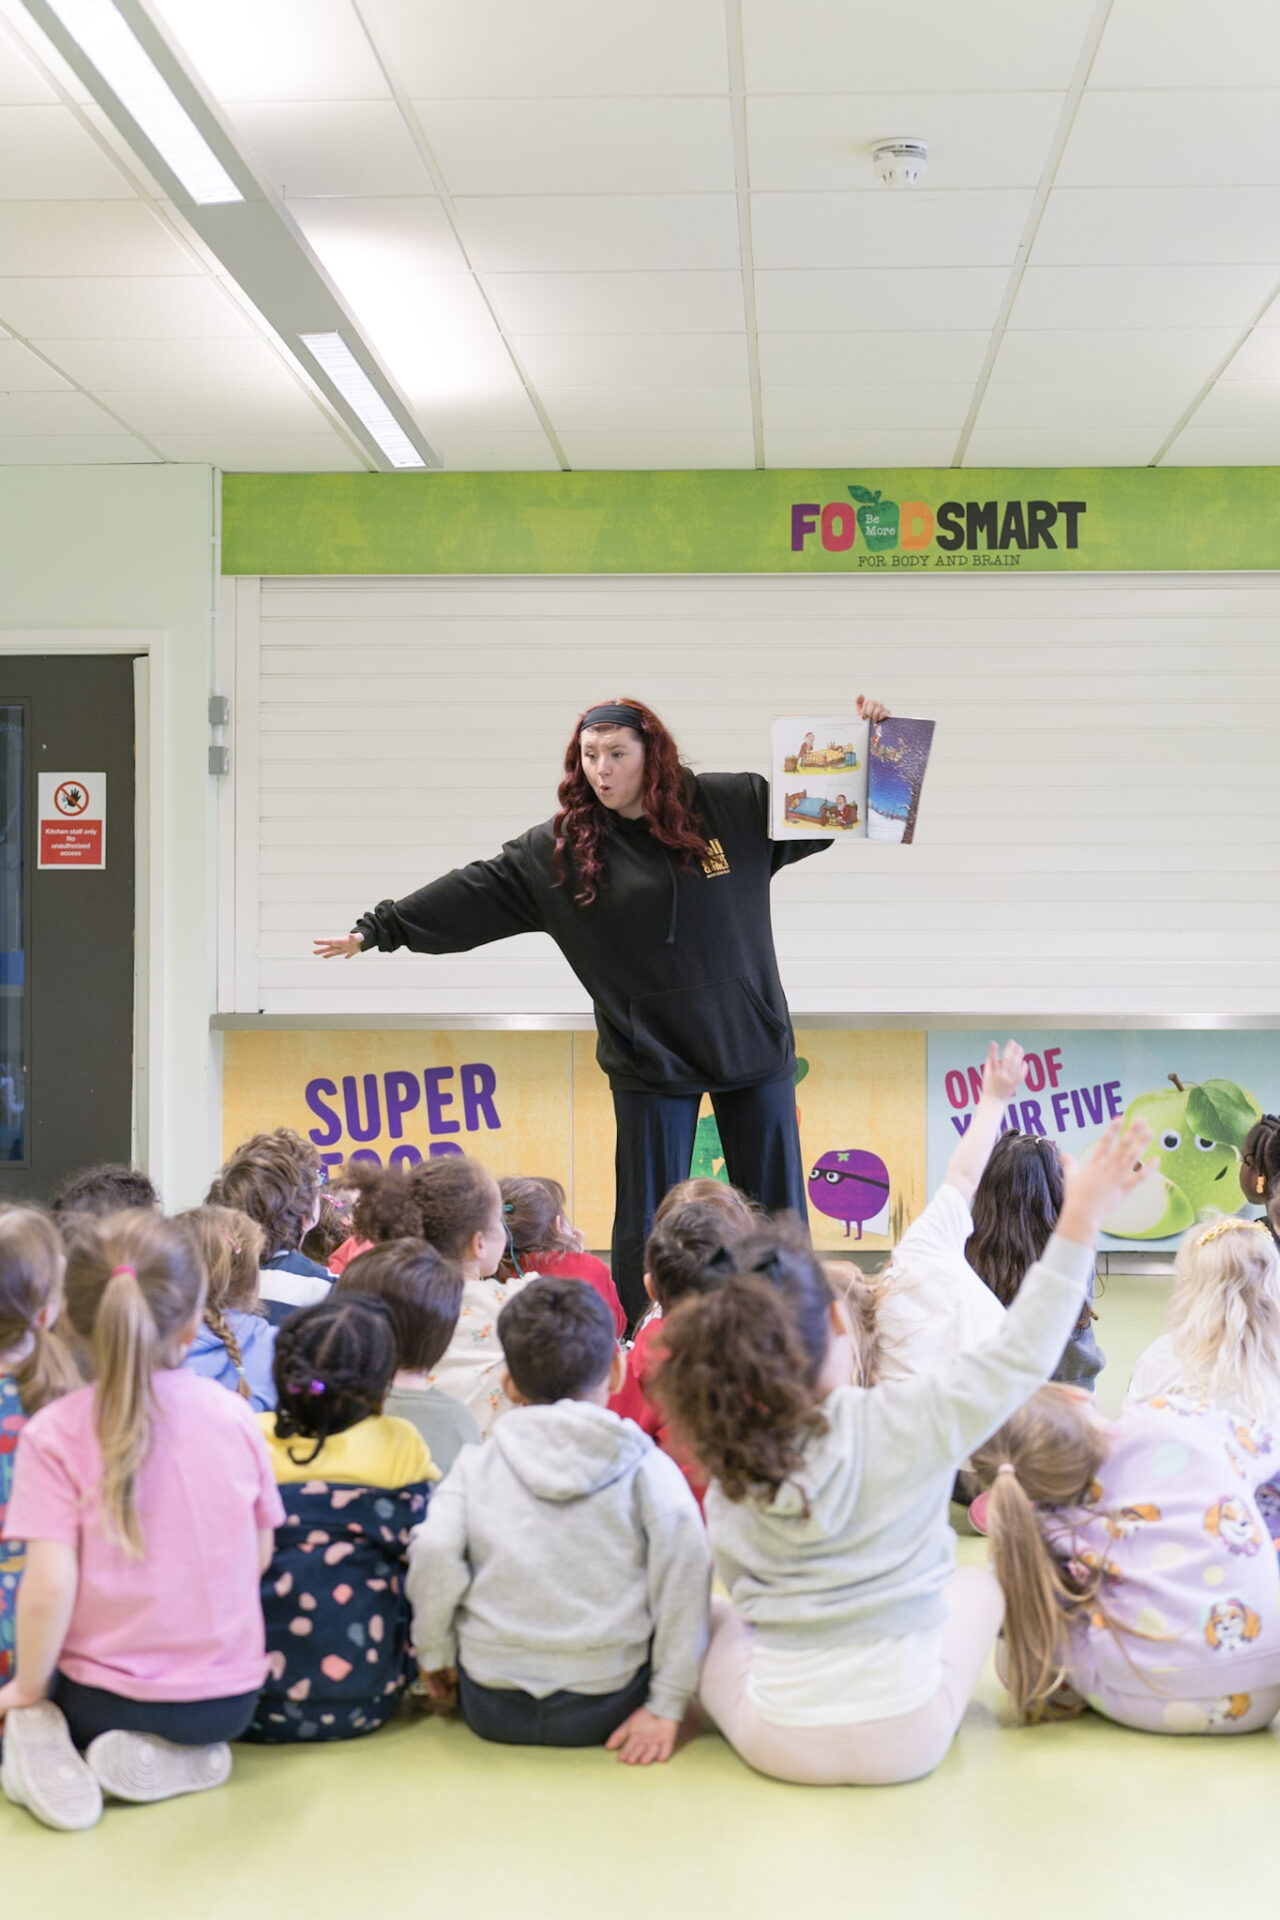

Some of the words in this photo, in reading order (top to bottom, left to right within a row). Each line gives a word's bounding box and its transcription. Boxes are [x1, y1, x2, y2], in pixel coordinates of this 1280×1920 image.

[865, 513, 880, 524] Be
[865, 525, 896, 537] More
[858, 555, 887, 568] FOR
[891, 555, 930, 568] BODY
[935, 554, 968, 567] AND
[972, 554, 1022, 567] BRAIN
[84, 828, 97, 836] only
[945, 1062, 1016, 1109] ON
[1023, 1047, 1063, 1092] OF
[305, 1063, 501, 1146] SUPER
[1051, 1080, 1124, 1132] FIVE
